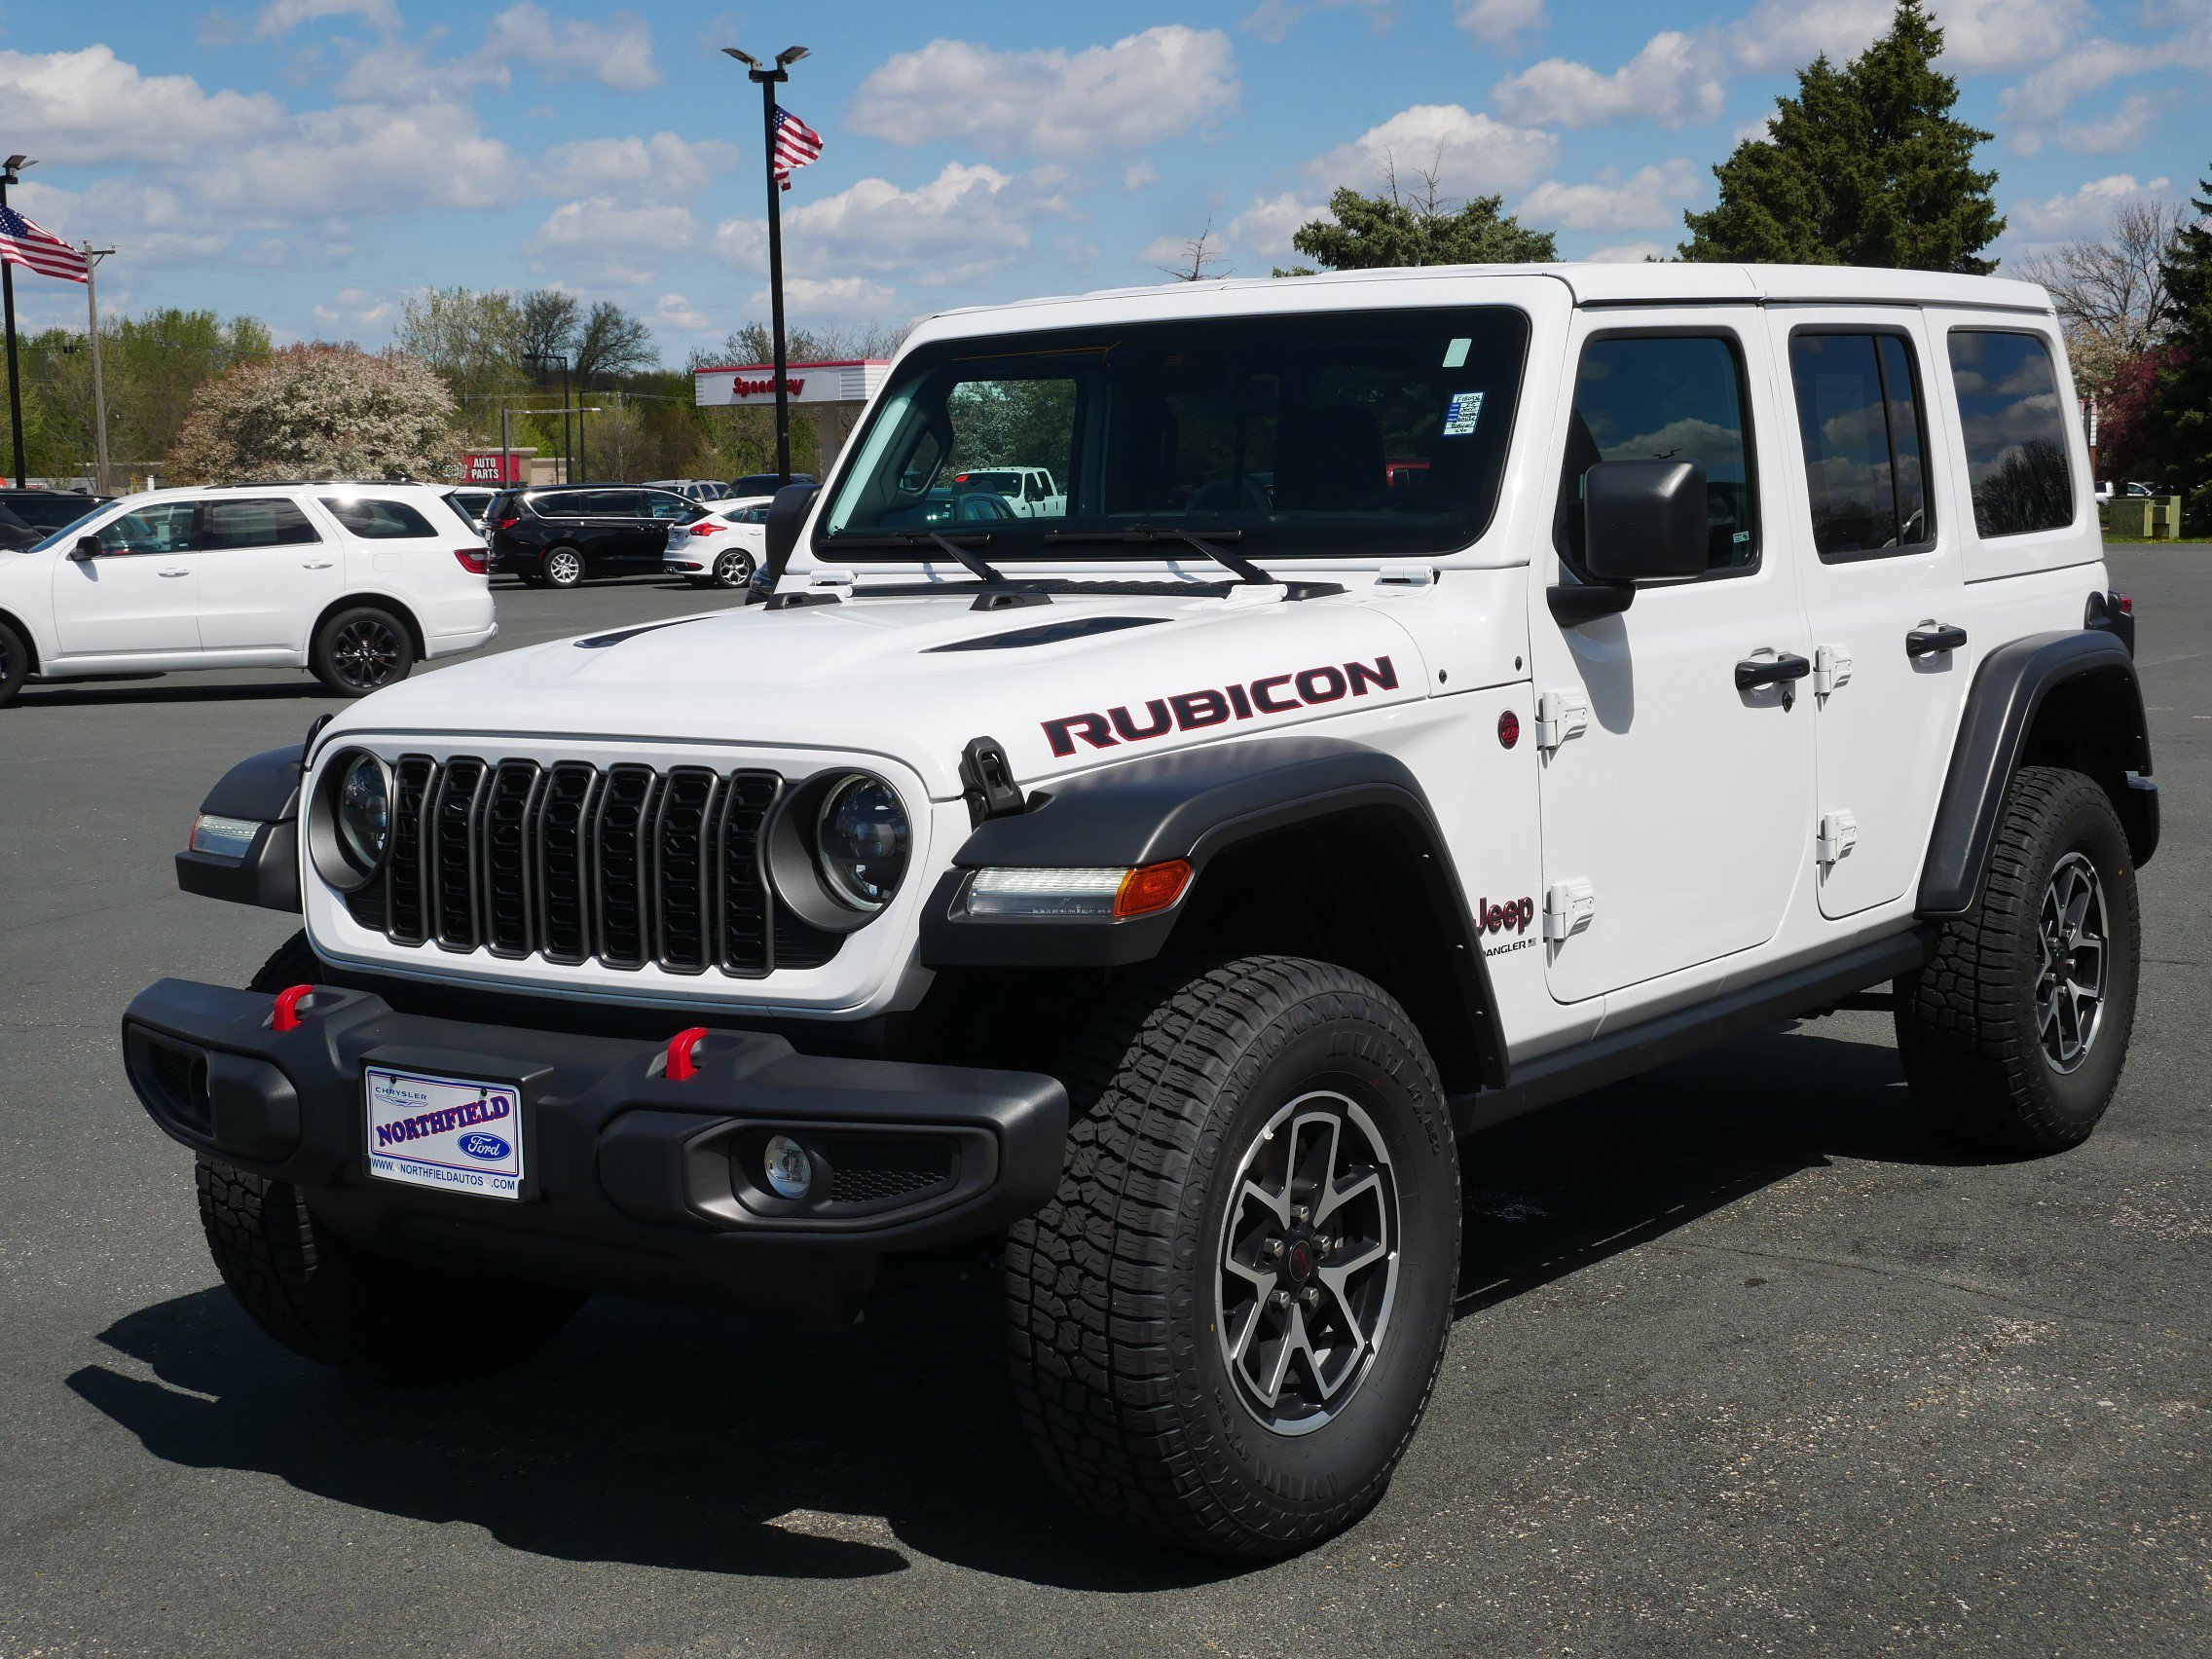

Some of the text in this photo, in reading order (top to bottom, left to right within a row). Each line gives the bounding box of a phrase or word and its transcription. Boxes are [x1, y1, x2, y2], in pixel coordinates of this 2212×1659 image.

[732, 376, 806, 398] Speeday
[471, 468, 499, 479] PARTS
[473, 458, 496, 468] AUTO
[1040, 655, 1400, 758] RUBICON
[1475, 896, 1534, 938] Jeep
[1484, 940, 1527, 957] ANGLER
[375, 1087, 427, 1101] CHRYSLER
[376, 1095, 510, 1148] NORTHFIELD
[467, 1135, 500, 1157] Ford
